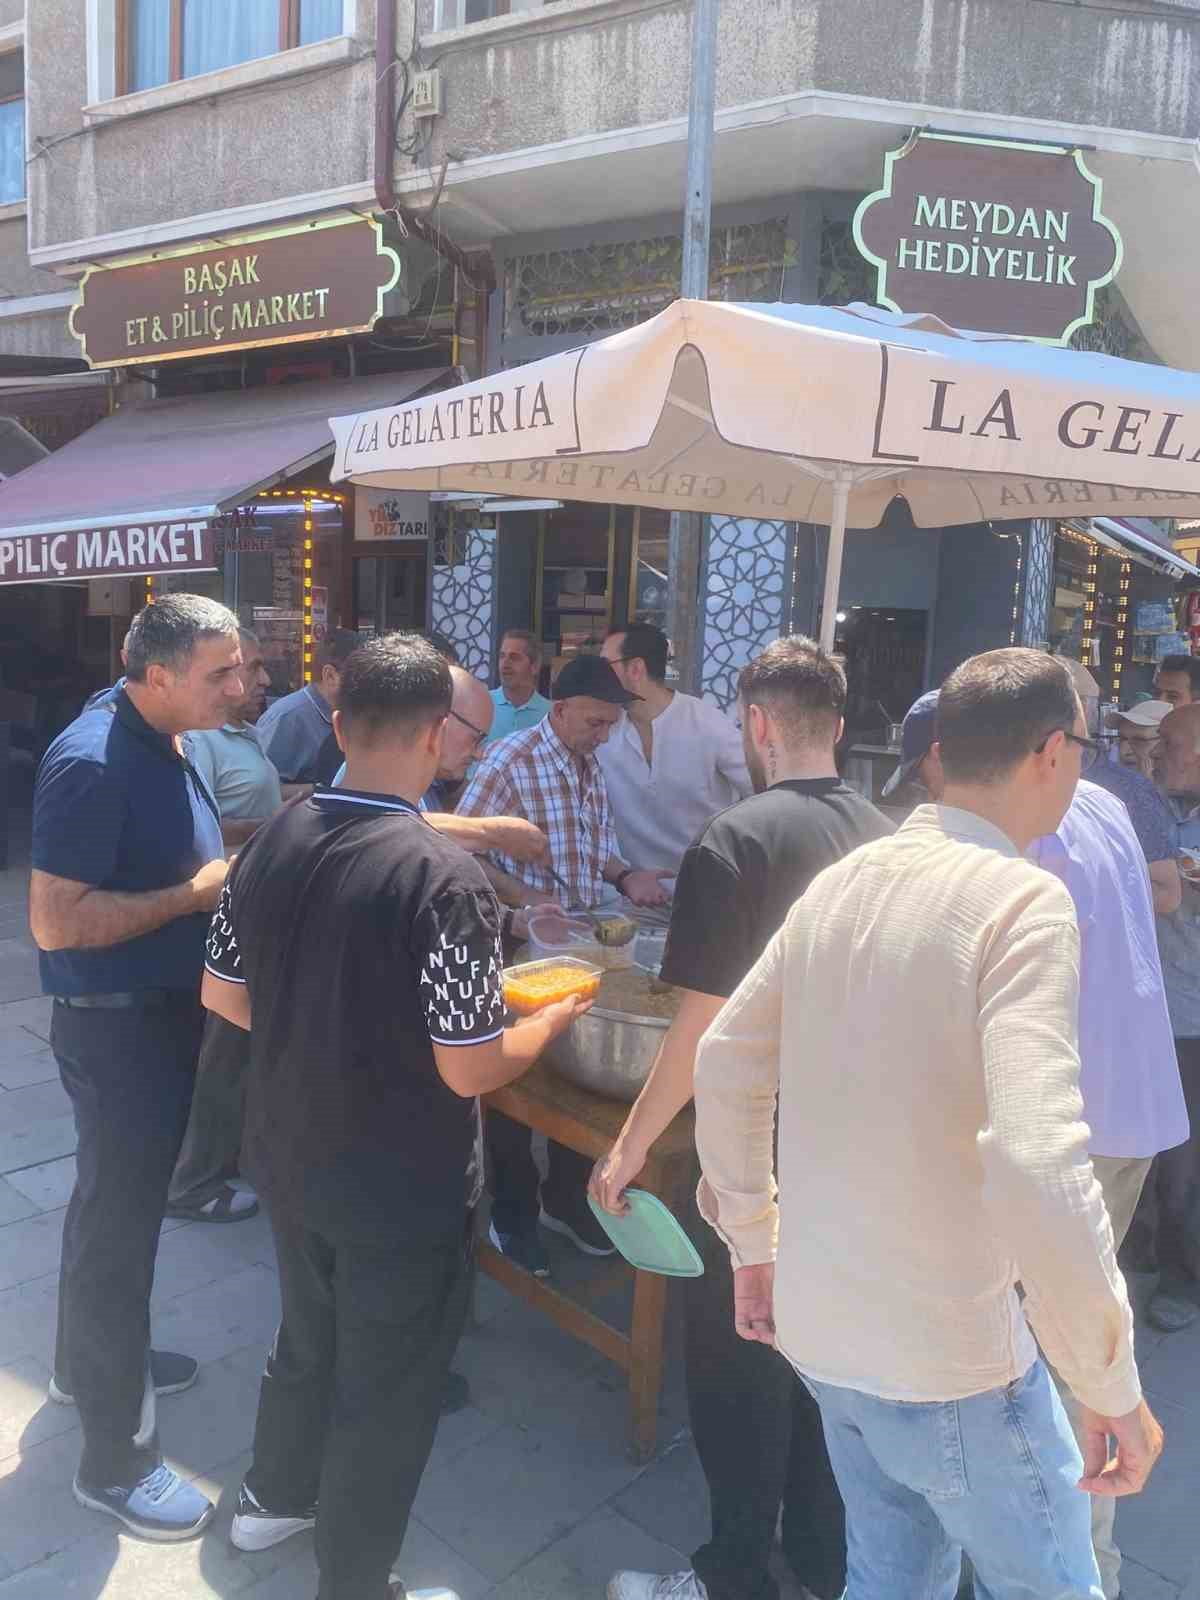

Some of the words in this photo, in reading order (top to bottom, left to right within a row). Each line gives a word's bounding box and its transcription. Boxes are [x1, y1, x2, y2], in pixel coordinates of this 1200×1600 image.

[914, 195, 1071, 243] MEYDAN
[184, 254, 261, 297] BAŞAK
[898, 236, 1077, 286] HEDİYELİK
[126, 317, 148, 346] ET
[151, 315, 168, 343] &
[172, 300, 225, 340] PİLİÇ
[231, 288, 330, 331] MARKET
[354, 421, 379, 454] LA
[387, 380, 554, 450] GELATERIA
[922, 379, 1021, 441] LA
[0, 534, 69, 576] PİLİÇ
[76, 521, 209, 569] MARKET
